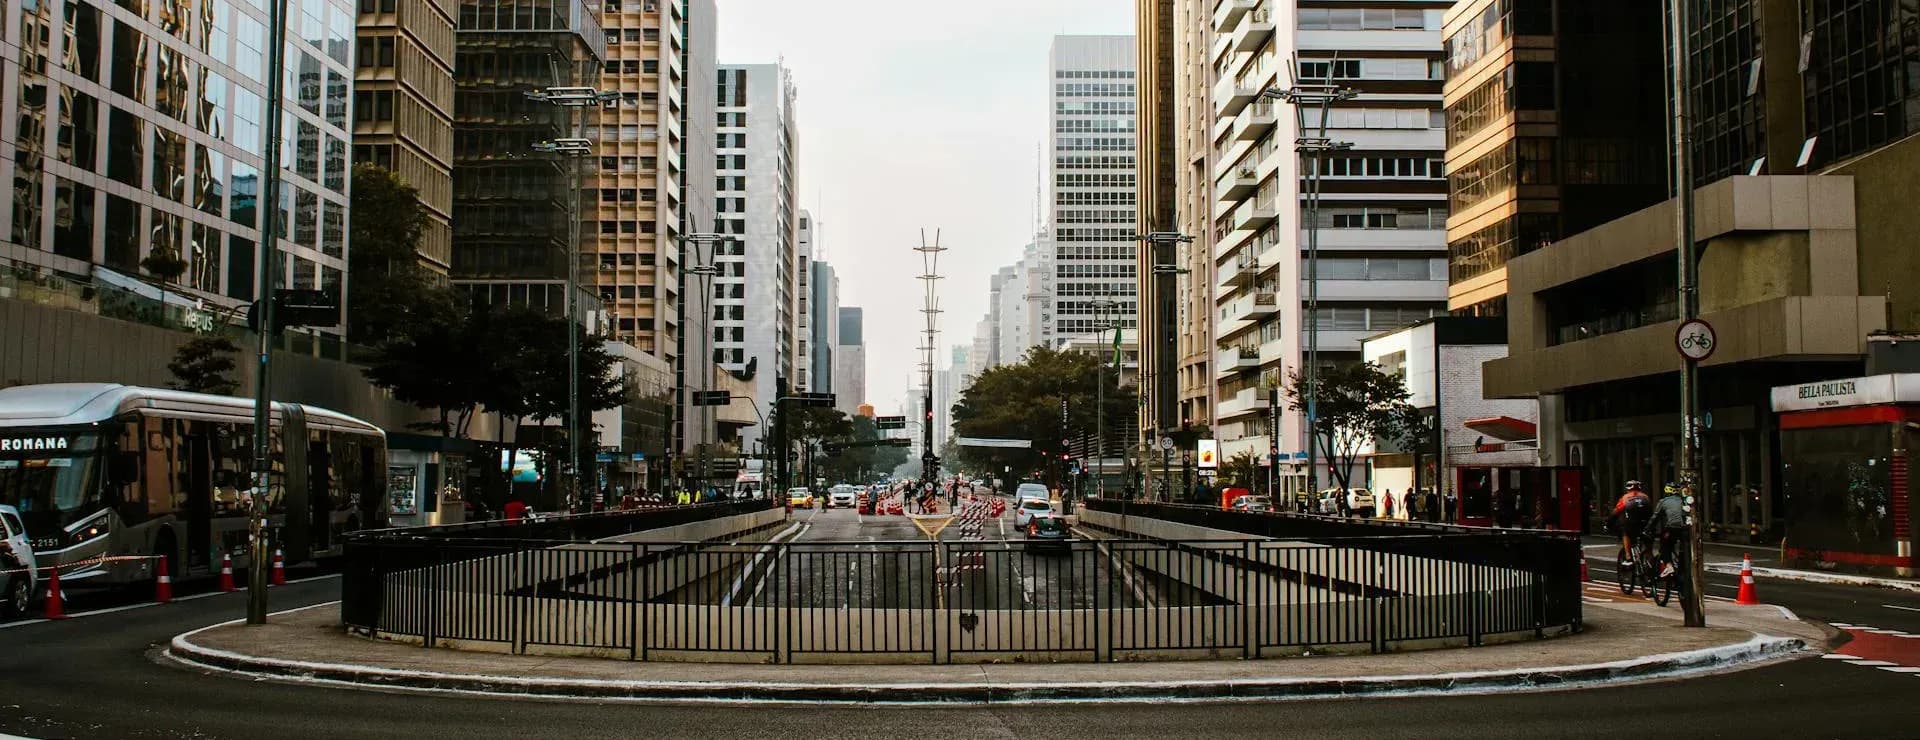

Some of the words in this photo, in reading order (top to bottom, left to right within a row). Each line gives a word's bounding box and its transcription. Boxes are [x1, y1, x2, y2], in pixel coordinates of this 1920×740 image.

[184, 306, 214, 336] Regus
[1798, 385, 1821, 399] BELLA
[1821, 381, 1857, 397] PAULISTA
[1, 437, 68, 451] ROMANA
[37, 537, 59, 547] 2151
